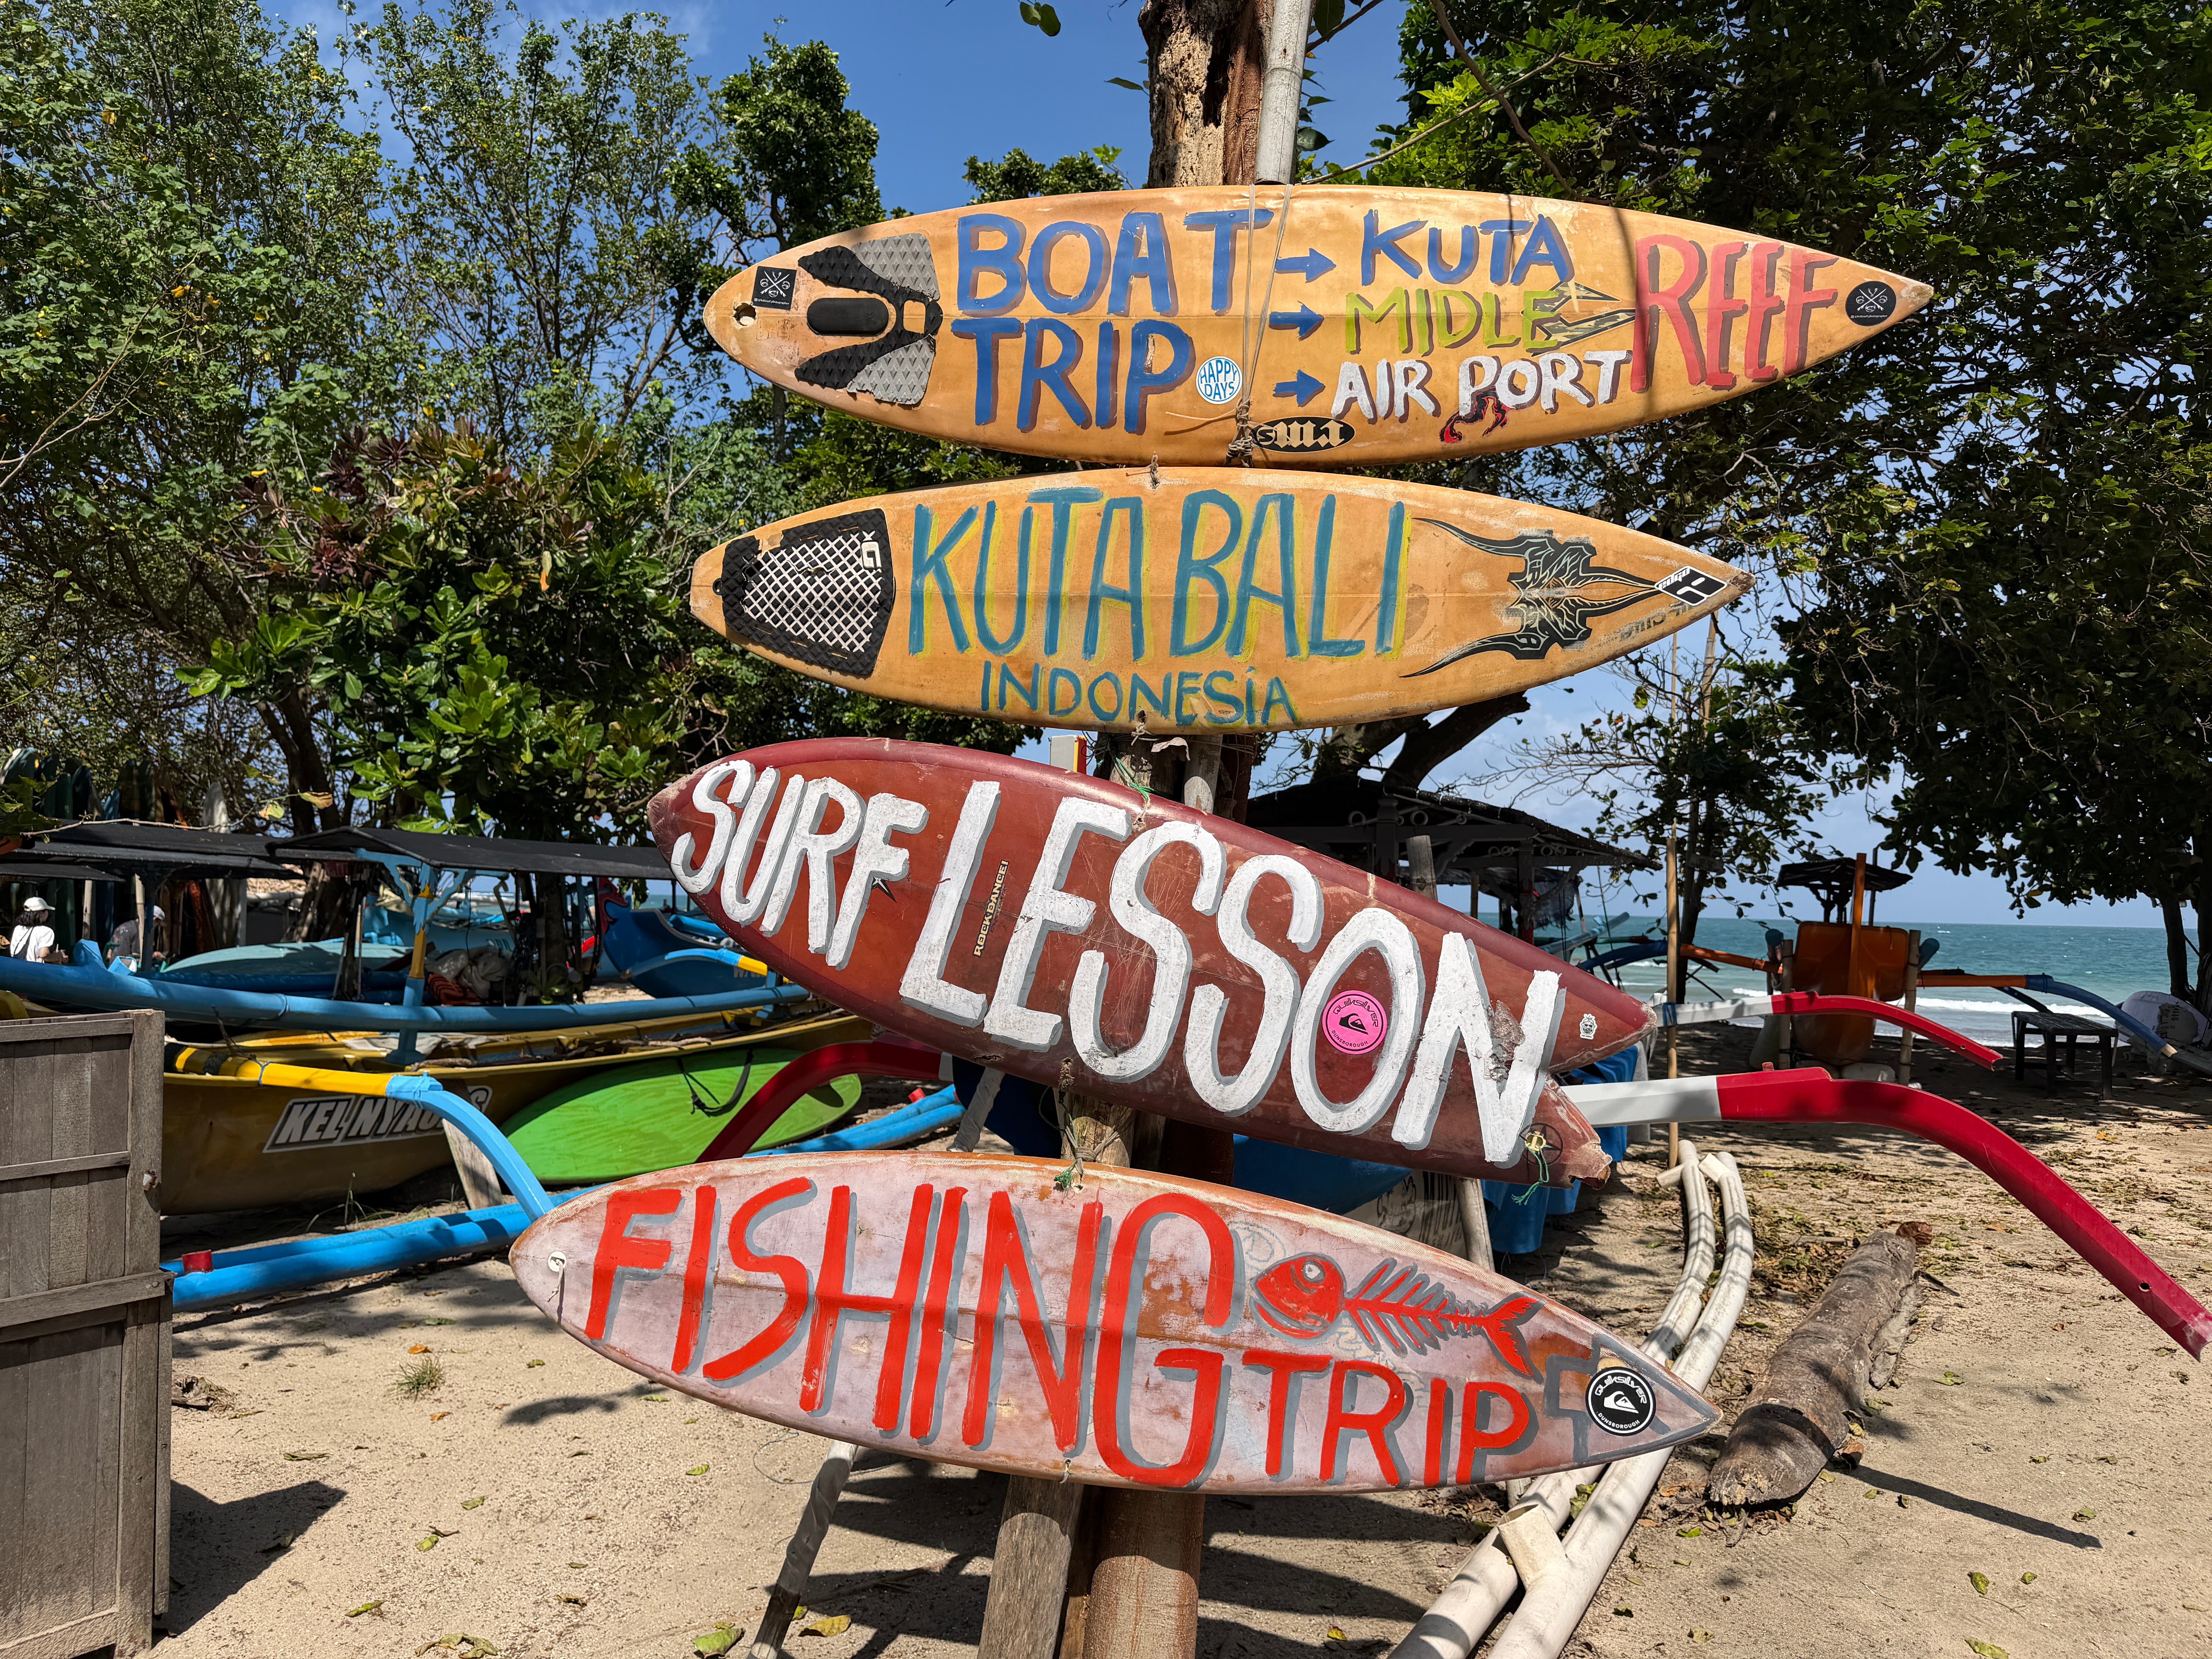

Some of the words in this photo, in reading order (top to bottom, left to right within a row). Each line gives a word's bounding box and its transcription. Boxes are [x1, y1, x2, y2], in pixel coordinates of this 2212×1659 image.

[958, 208, 1274, 316] BOAT
[1361, 209, 1574, 286] KUTA
[1345, 286, 1564, 356] MIDLE
[1630, 234, 1839, 393] REEF
[951, 317, 1195, 435] TRIP
[1200, 359, 1237, 384] HAPPY
[1204, 381, 1235, 400] DAYS
[1331, 358, 1441, 424] AIR
[1459, 350, 1632, 418] PORT
[908, 487, 1153, 665] KUTA
[1170, 488, 1412, 663] BALI
[671, 759, 929, 971] SURF
[899, 780, 1565, 1169] LESSON
[1331, 1030, 1368, 1048] DUNSBOROUGH
[584, 1177, 1245, 1489] FISHING
[1241, 1348, 1539, 1489] TRIP
[1598, 1412, 1640, 1429] DUNSBOROUGH
